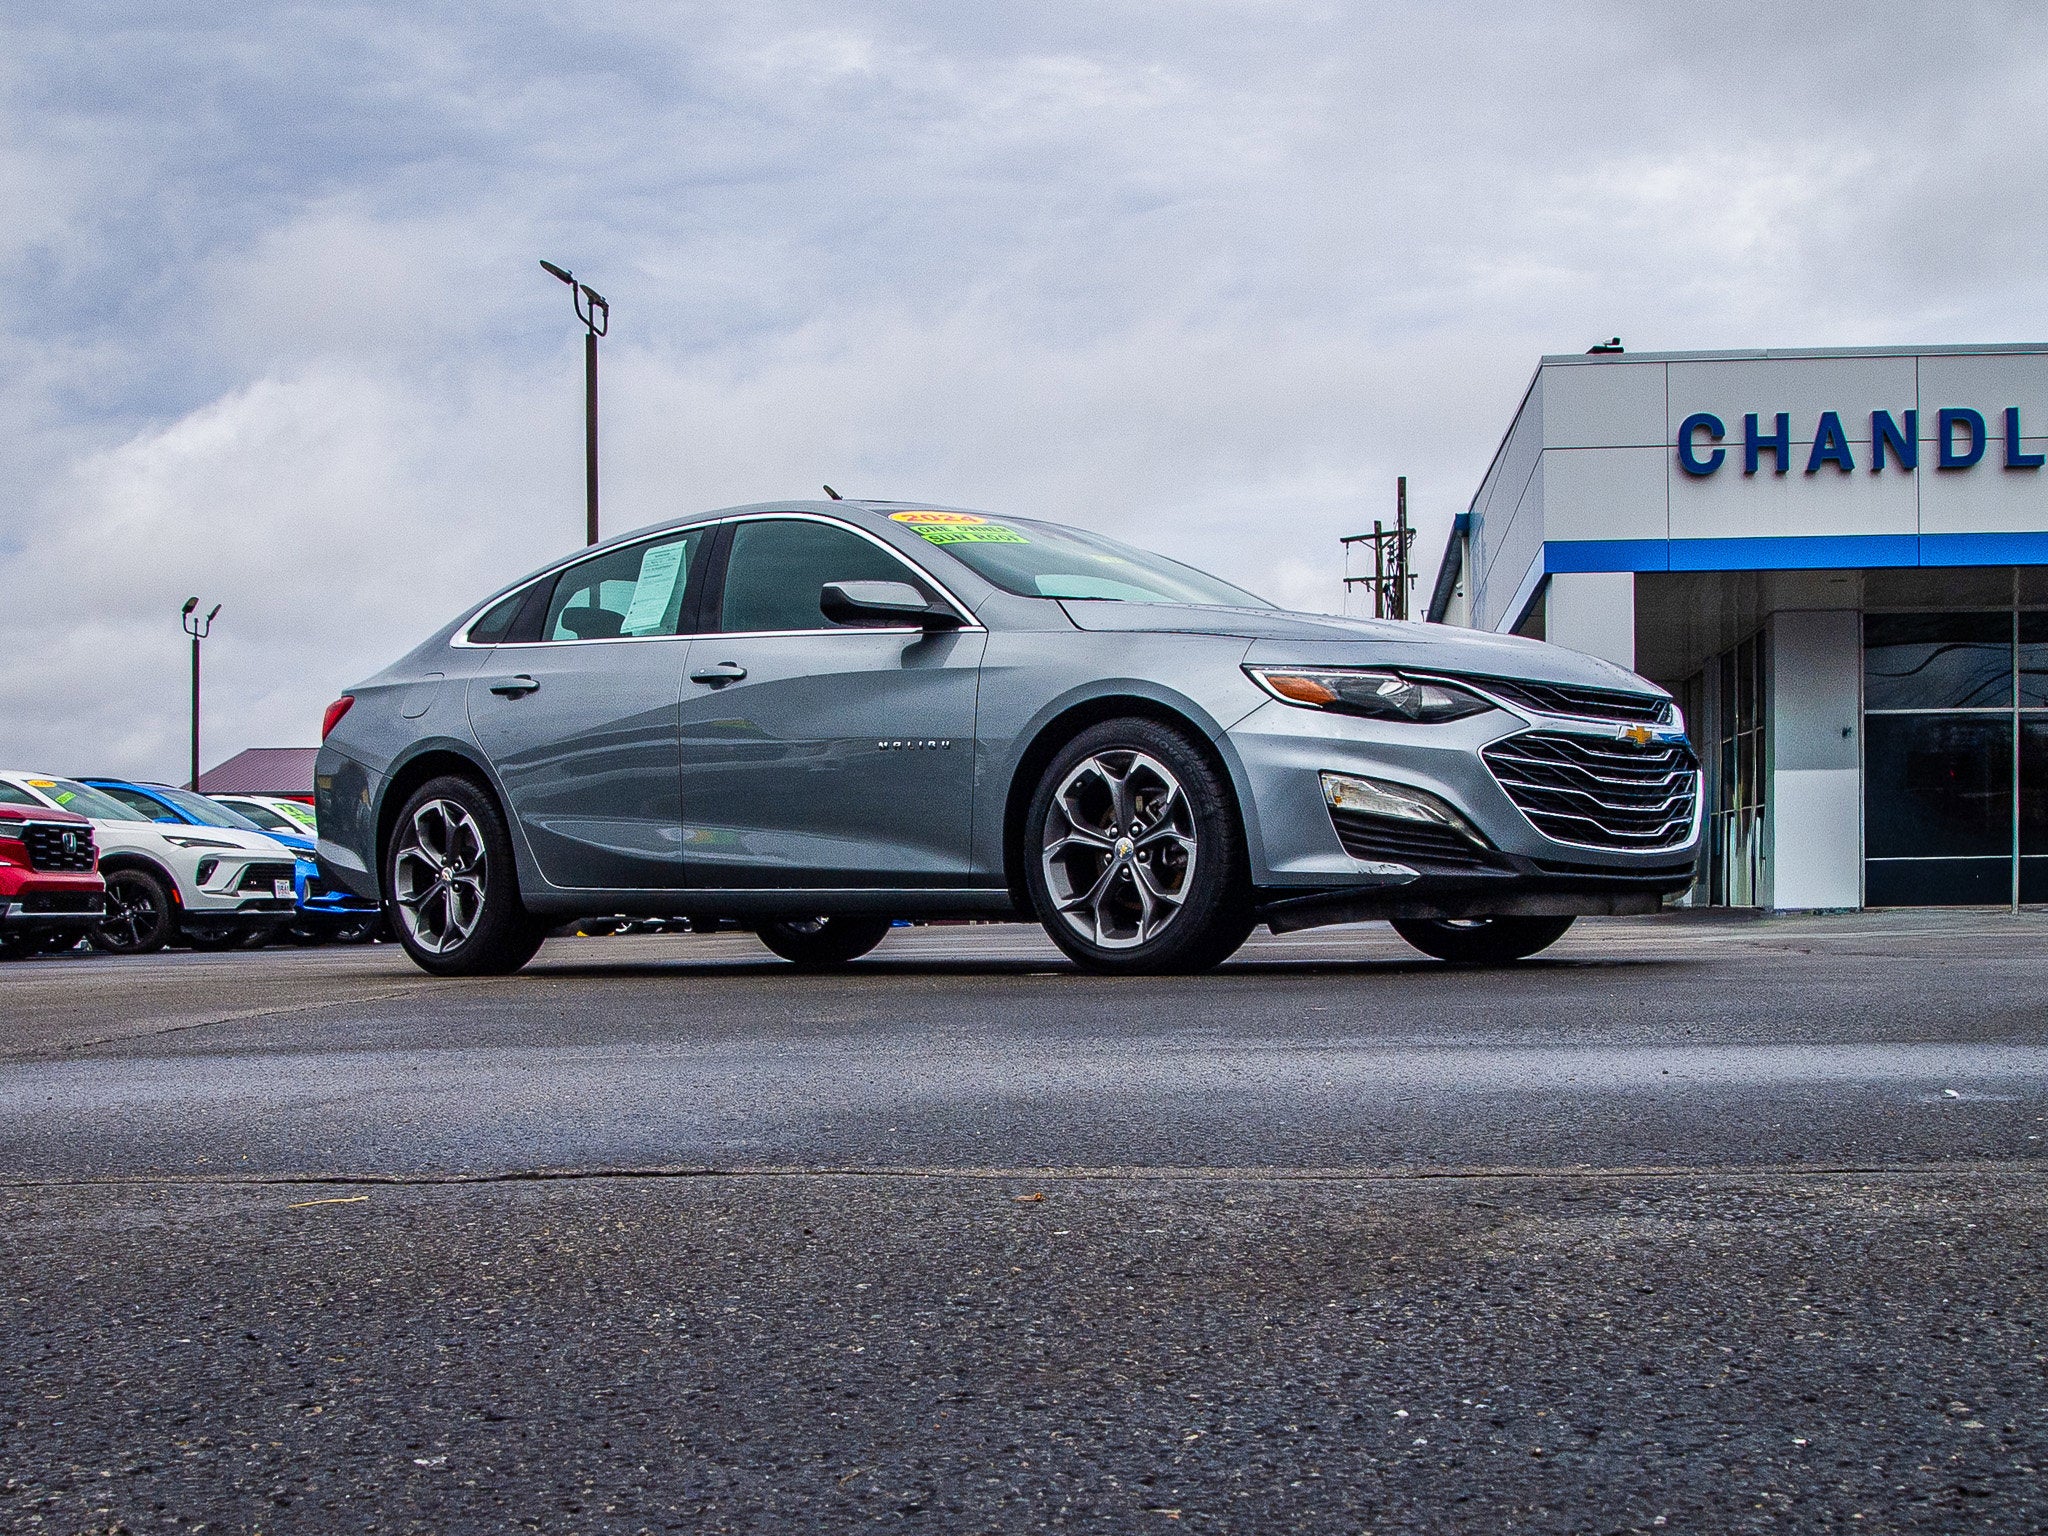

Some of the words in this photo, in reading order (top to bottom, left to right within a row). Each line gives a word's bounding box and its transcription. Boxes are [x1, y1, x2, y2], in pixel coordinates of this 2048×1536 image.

[1677, 406, 2046, 476] CHANDL
[902, 513, 980, 523] 2024
[917, 525, 952, 534] ONE
[929, 533, 970, 543] SUN
